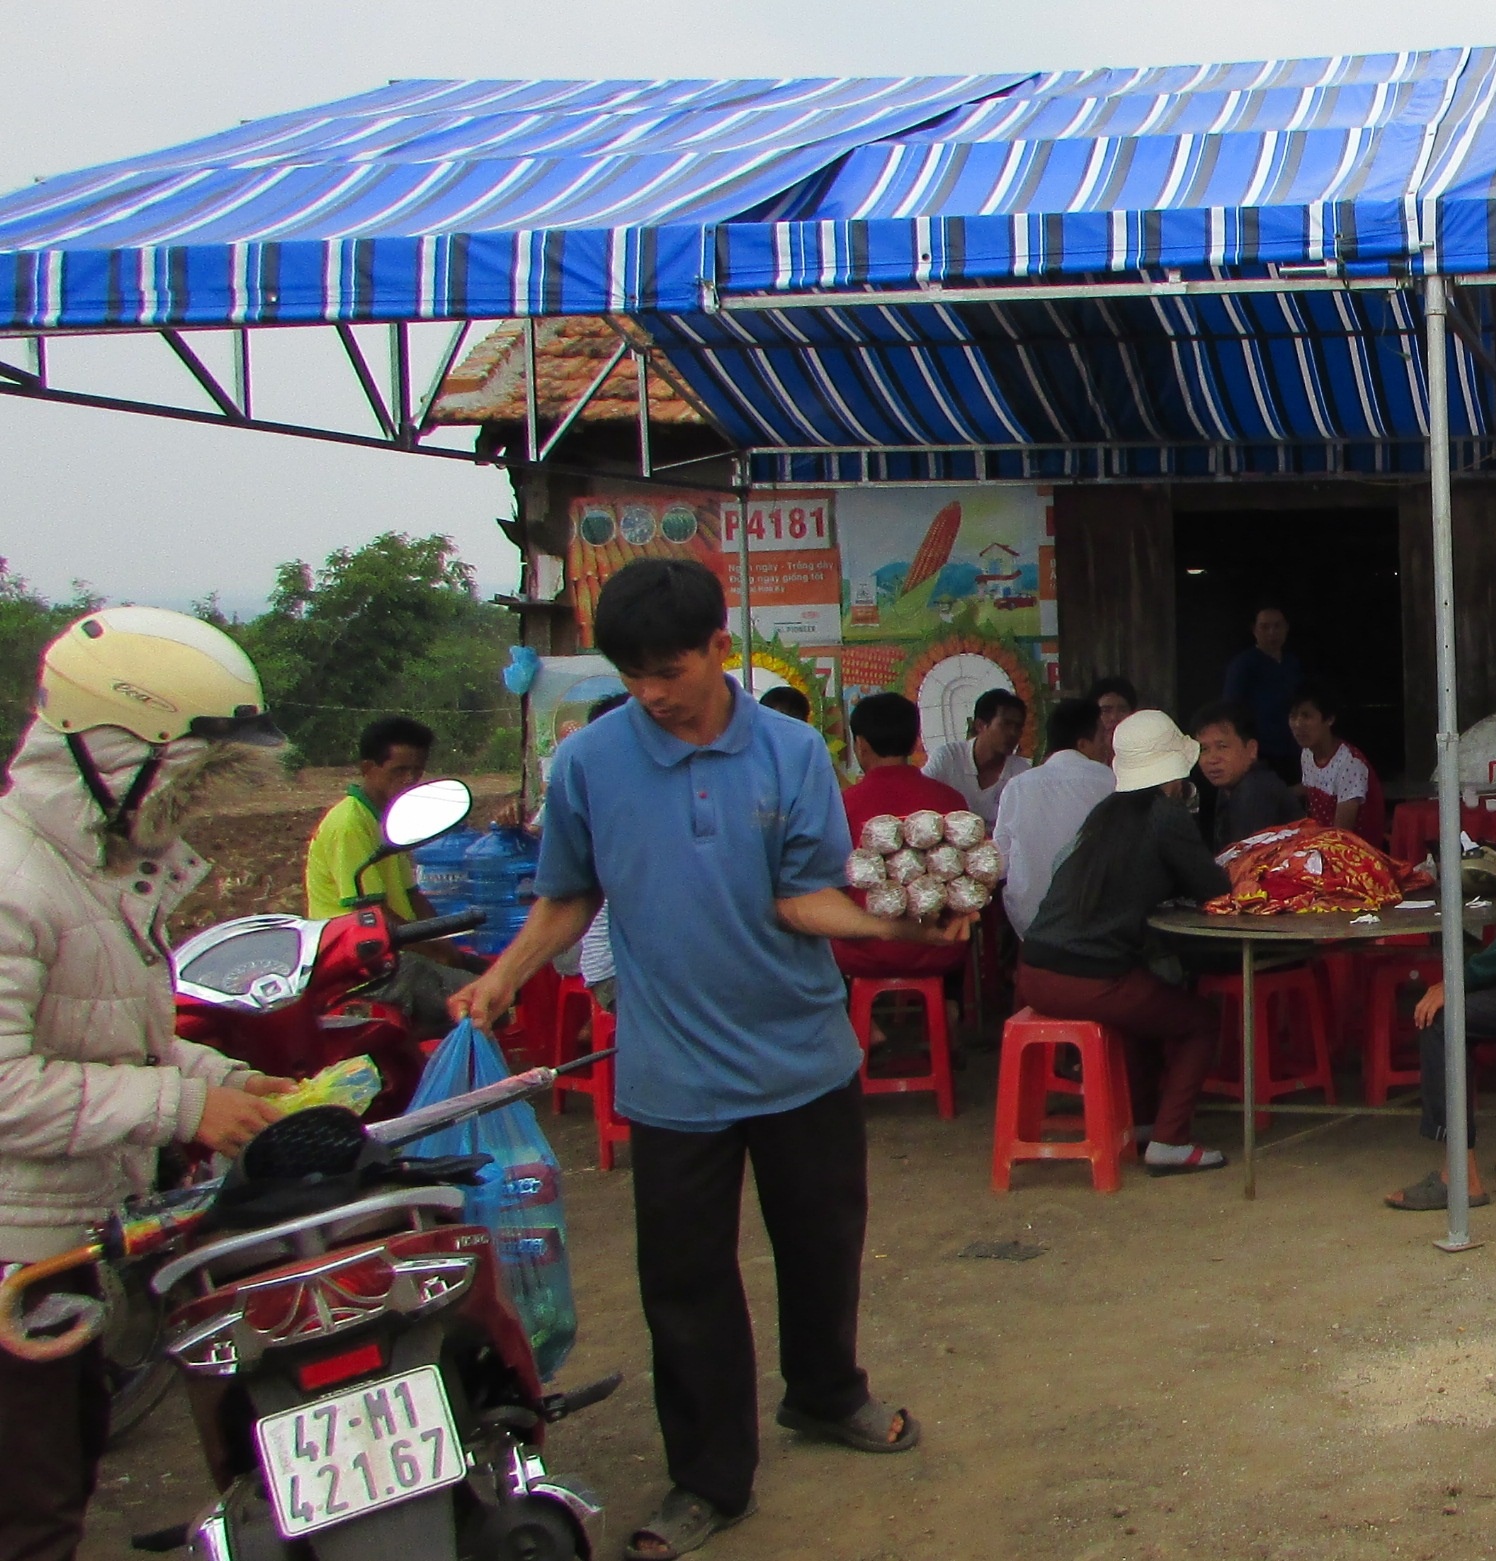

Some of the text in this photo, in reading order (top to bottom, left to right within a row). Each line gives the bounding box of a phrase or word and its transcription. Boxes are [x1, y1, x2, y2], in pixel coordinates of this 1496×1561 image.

[725, 507, 824, 540] P4181
[728, 563, 752, 574] Ngn
[294, 1381, 420, 1462] 47-M1
[290, 1427, 445, 1522] 421.67
